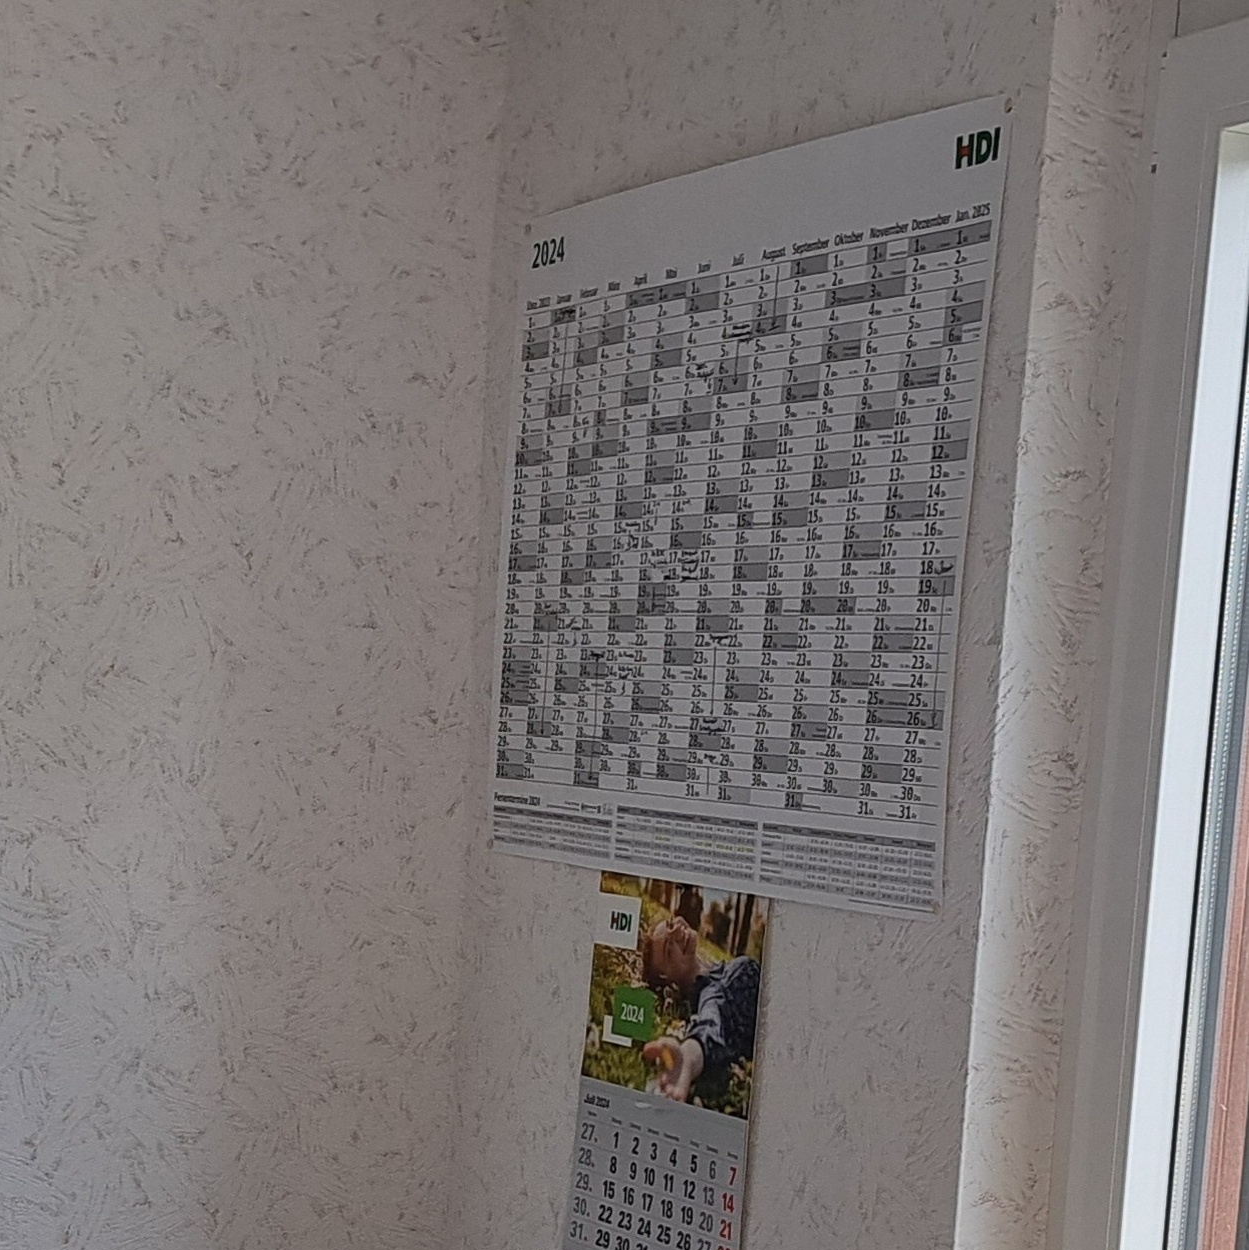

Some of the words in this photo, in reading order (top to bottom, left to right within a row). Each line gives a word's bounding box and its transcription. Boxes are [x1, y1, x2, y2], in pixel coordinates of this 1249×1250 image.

[955, 127, 1001, 169] HDI
[532, 236, 564, 269] 2024
[792, 239, 830, 255] September
[834, 231, 863, 247] Oktober
[870, 222, 908, 239] November
[911, 215, 951, 231] Dezember
[610, 911, 632, 932] HDI
[621, 1003, 644, 1024] 2024
[581, 1122, 598, 1143] 27.
[613, 1131, 619, 1149] 1
[632, 1137, 639, 1155] 2
[651, 1143, 657, 1160] 3
[670, 1149, 677, 1167] 4
[691, 1155, 697, 1173] 5
[709, 1160, 716, 1179] 6
[730, 1166, 737, 1186] 7
[578, 1147, 595, 1168] 28.
[610, 1156, 617, 1174] 8
[629, 1162, 637, 1180] 9
[644, 1167, 655, 1186] 10
[664, 1173, 674, 1193] 11
[683, 1179, 696, 1200] 12
[703, 1186, 715, 1206] 13
[722, 1193, 734, 1213] 14
[573, 1196, 590, 1217] 30.
[598, 1204, 613, 1224] 22
[618, 1211, 632, 1231] 23
[637, 1217, 651, 1238] 24
[657, 1224, 671, 1244] 25
[576, 1172, 592, 1192] 29.
[603, 1180, 615, 1199] 15
[623, 1186, 635, 1205] 16
[642, 1193, 654, 1212] 17
[661, 1199, 673, 1219] 18
[681, 1206, 693, 1226] 19
[699, 1212, 713, 1232] 20
[720, 1219, 732, 1240] 21
[570, 1221, 588, 1241] 31.
[595, 1229, 610, 1249] 29
